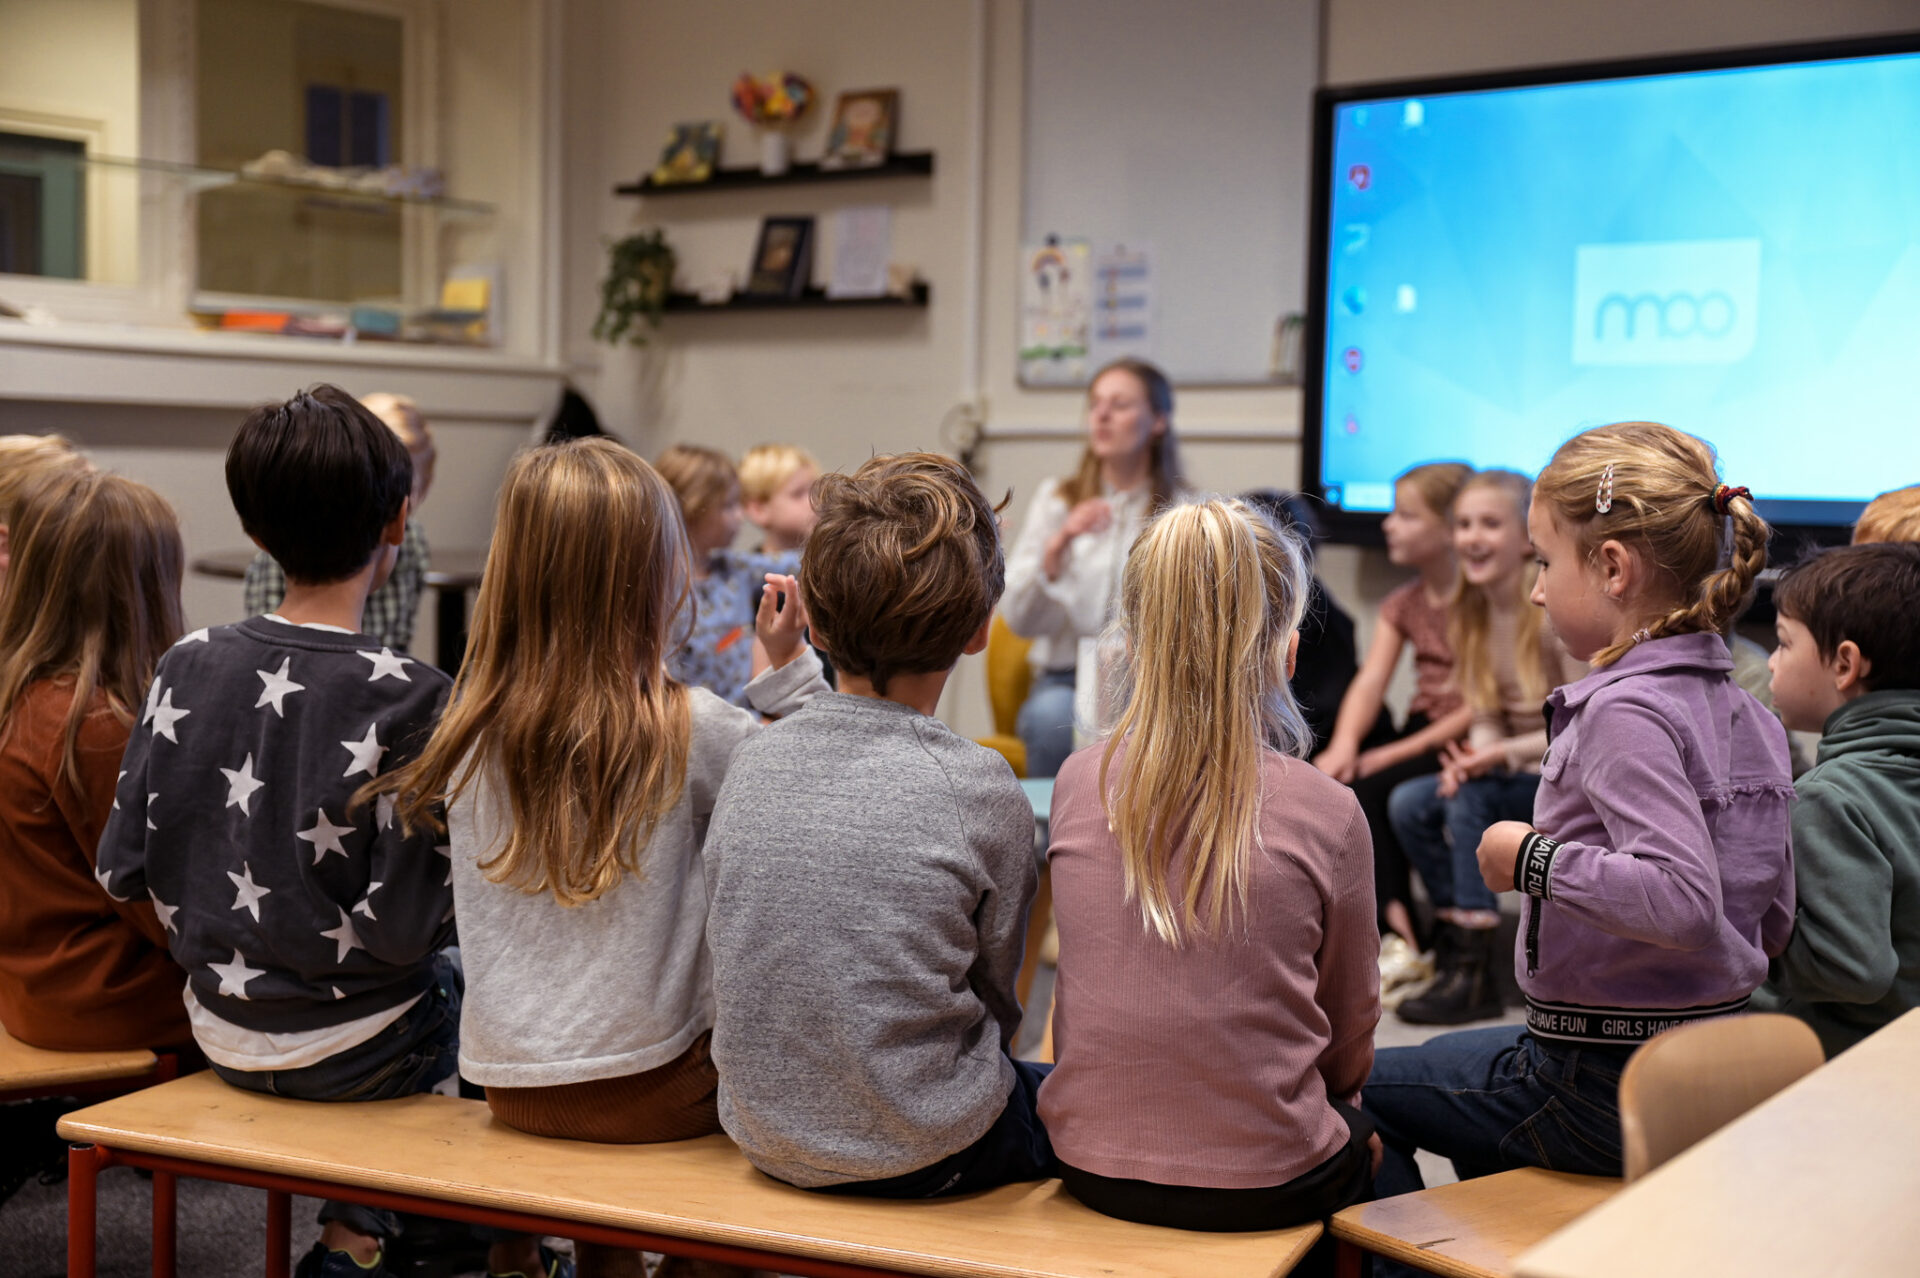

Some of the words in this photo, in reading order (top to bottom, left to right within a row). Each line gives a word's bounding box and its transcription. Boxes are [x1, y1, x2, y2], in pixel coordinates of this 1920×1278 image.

[1530, 836, 1557, 872] HAVE
[1528, 871, 1543, 897] FUN
[1560, 1015, 1587, 1034] FUN
[1602, 1019, 1644, 1036] GIRLS
